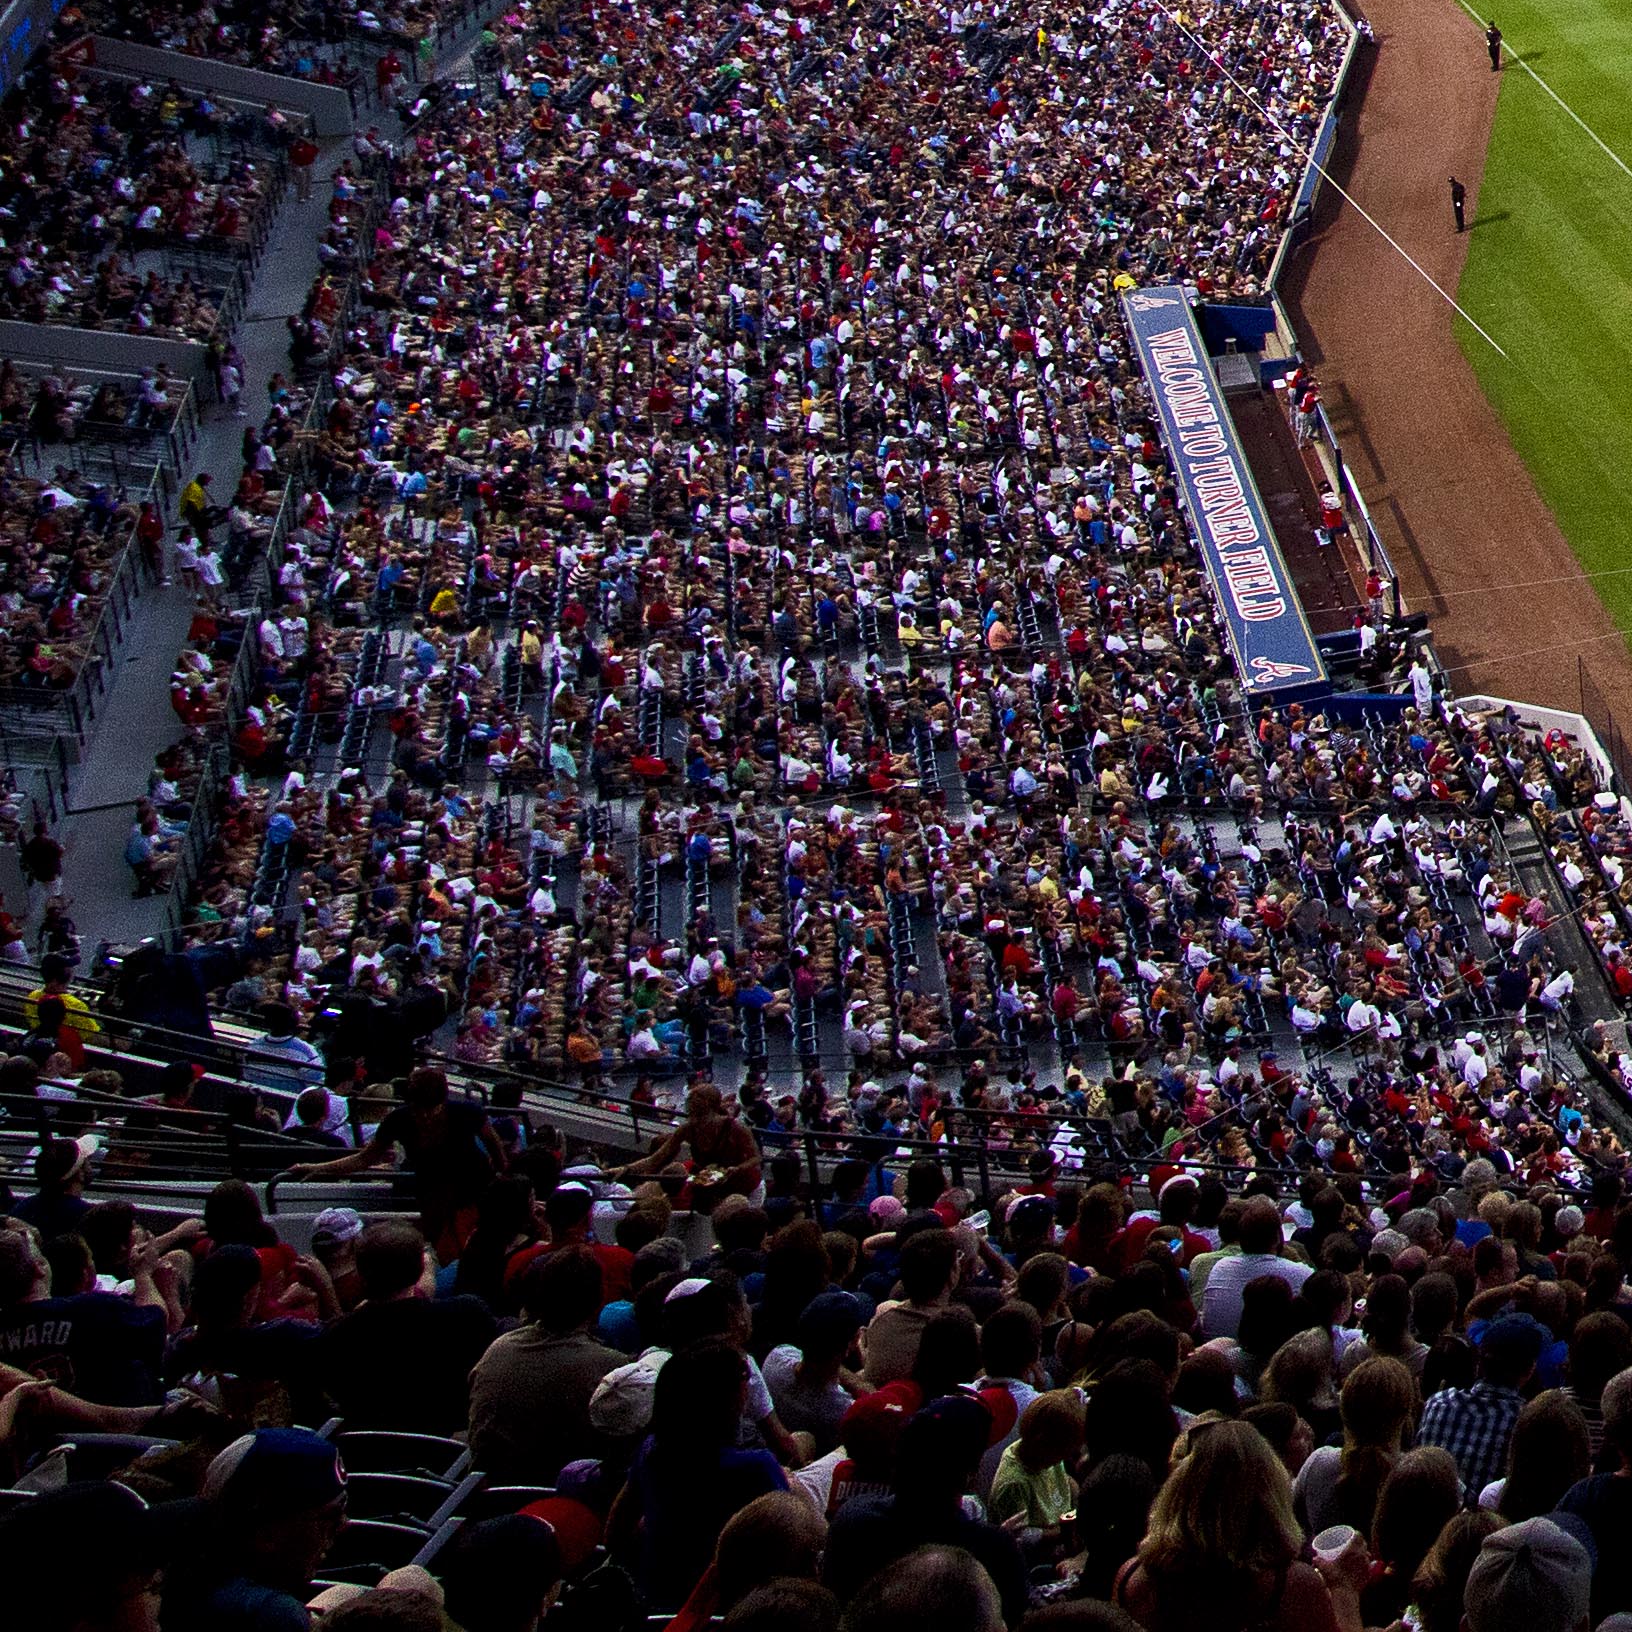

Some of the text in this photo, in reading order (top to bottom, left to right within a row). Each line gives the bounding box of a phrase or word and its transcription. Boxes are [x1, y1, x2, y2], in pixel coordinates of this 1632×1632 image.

[1146, 326, 1288, 623] WELCOME TO TURNER FIELD
